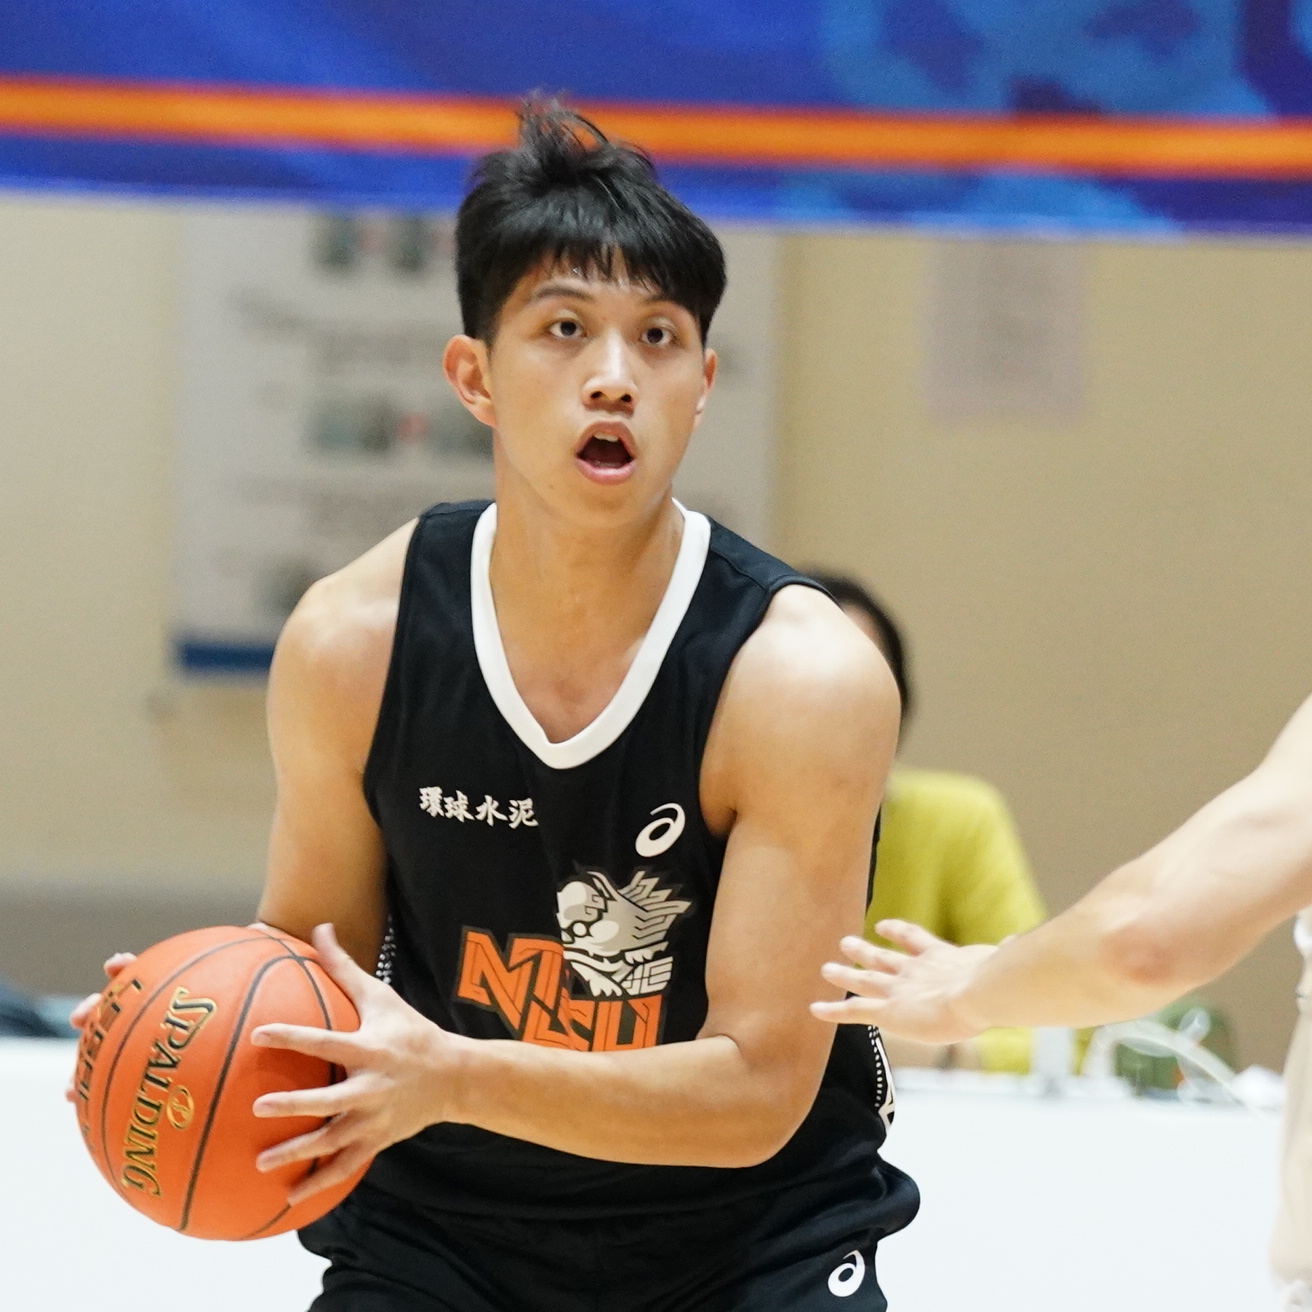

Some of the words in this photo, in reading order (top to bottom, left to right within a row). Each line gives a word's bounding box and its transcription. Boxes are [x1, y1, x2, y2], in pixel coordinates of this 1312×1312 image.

[419, 786, 539, 829] 環球水泥
[122, 987, 217, 1198] SPALDING
